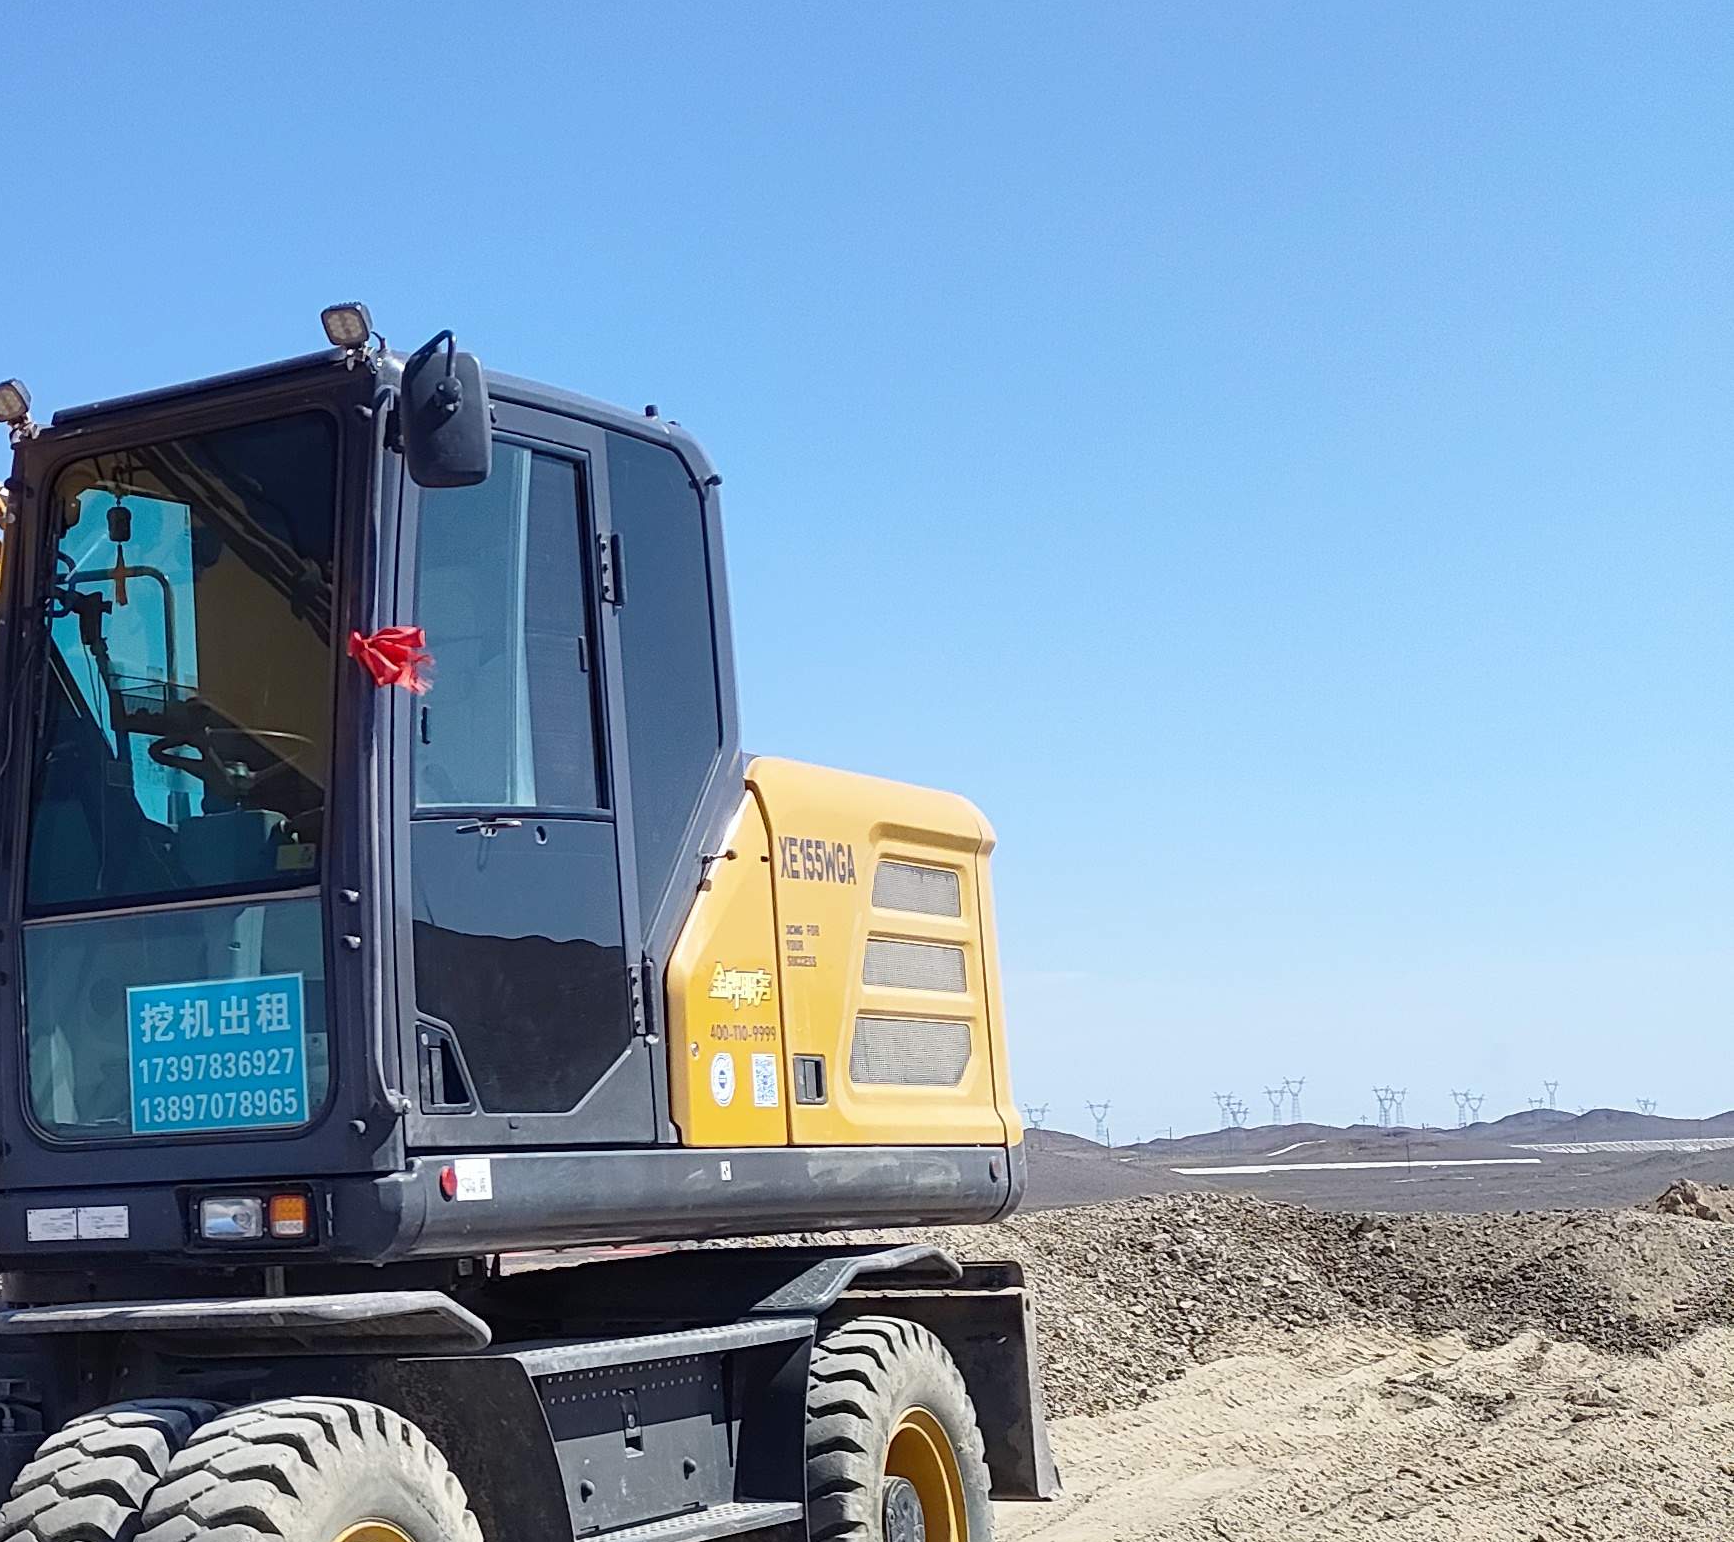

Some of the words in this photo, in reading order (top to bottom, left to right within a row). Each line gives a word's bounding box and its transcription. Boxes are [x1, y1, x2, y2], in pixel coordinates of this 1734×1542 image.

[778, 836, 857, 885] XE155WGA
[140, 992, 291, 1043] 挖机出租
[139, 1048, 295, 1083] 17397836927
[140, 1088, 298, 1123] 13897078965
